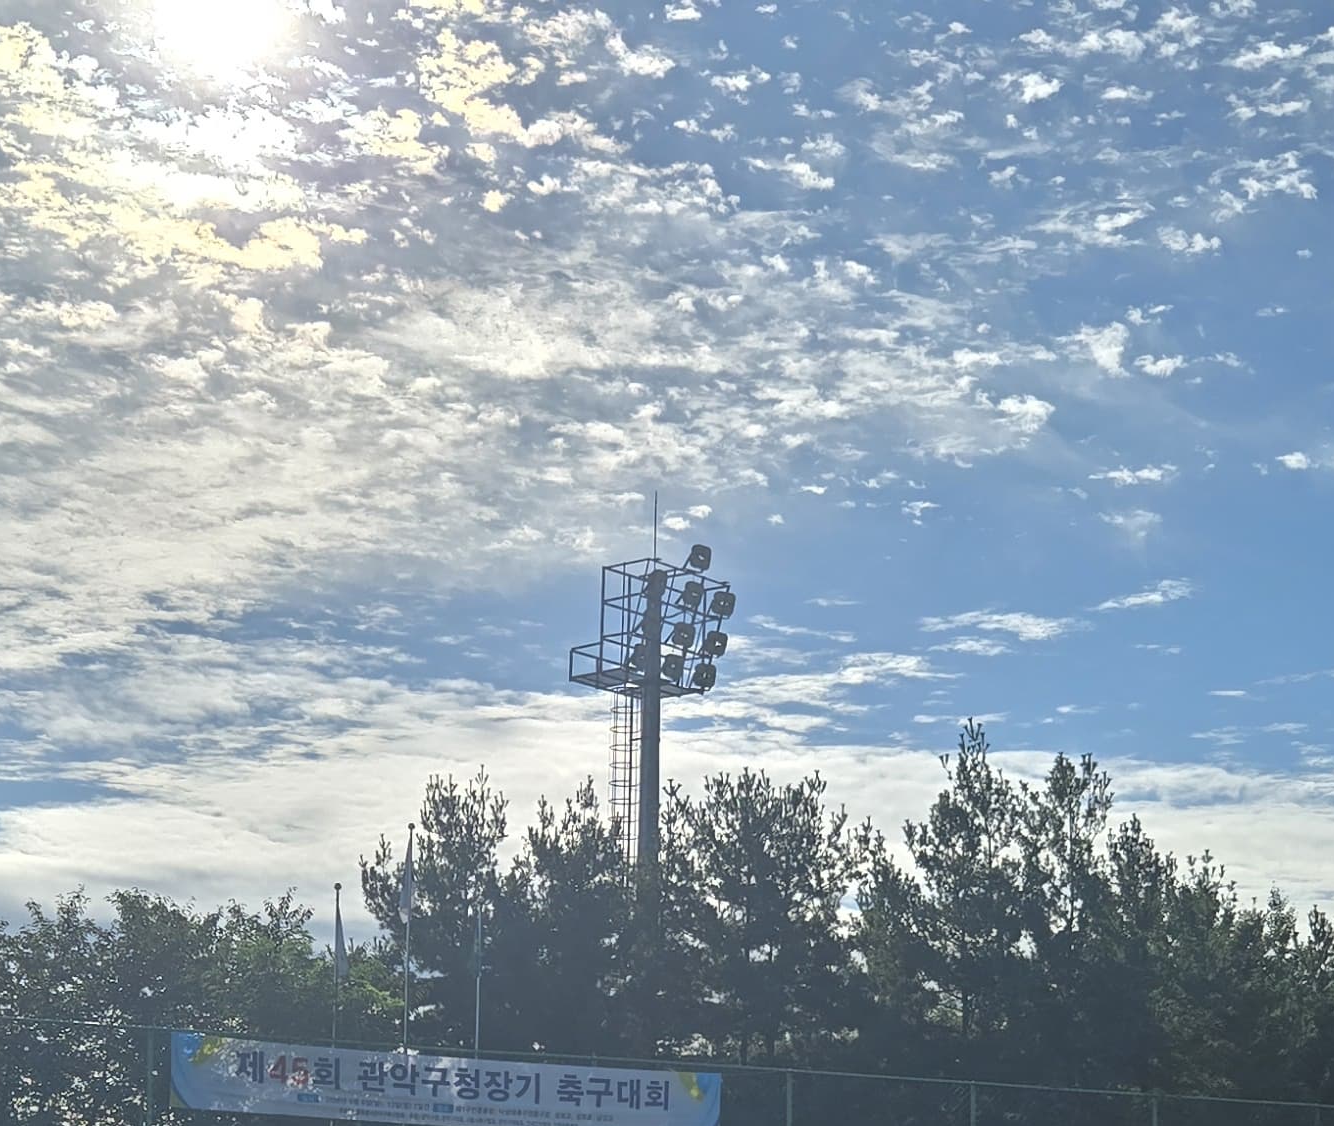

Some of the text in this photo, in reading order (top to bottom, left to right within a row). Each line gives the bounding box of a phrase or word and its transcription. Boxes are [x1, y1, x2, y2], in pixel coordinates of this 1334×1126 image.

[235, 1050, 341, 1089] 제45회
[358, 1061, 541, 1104] 관악구청장기
[557, 1076, 671, 1111] 축구대회
